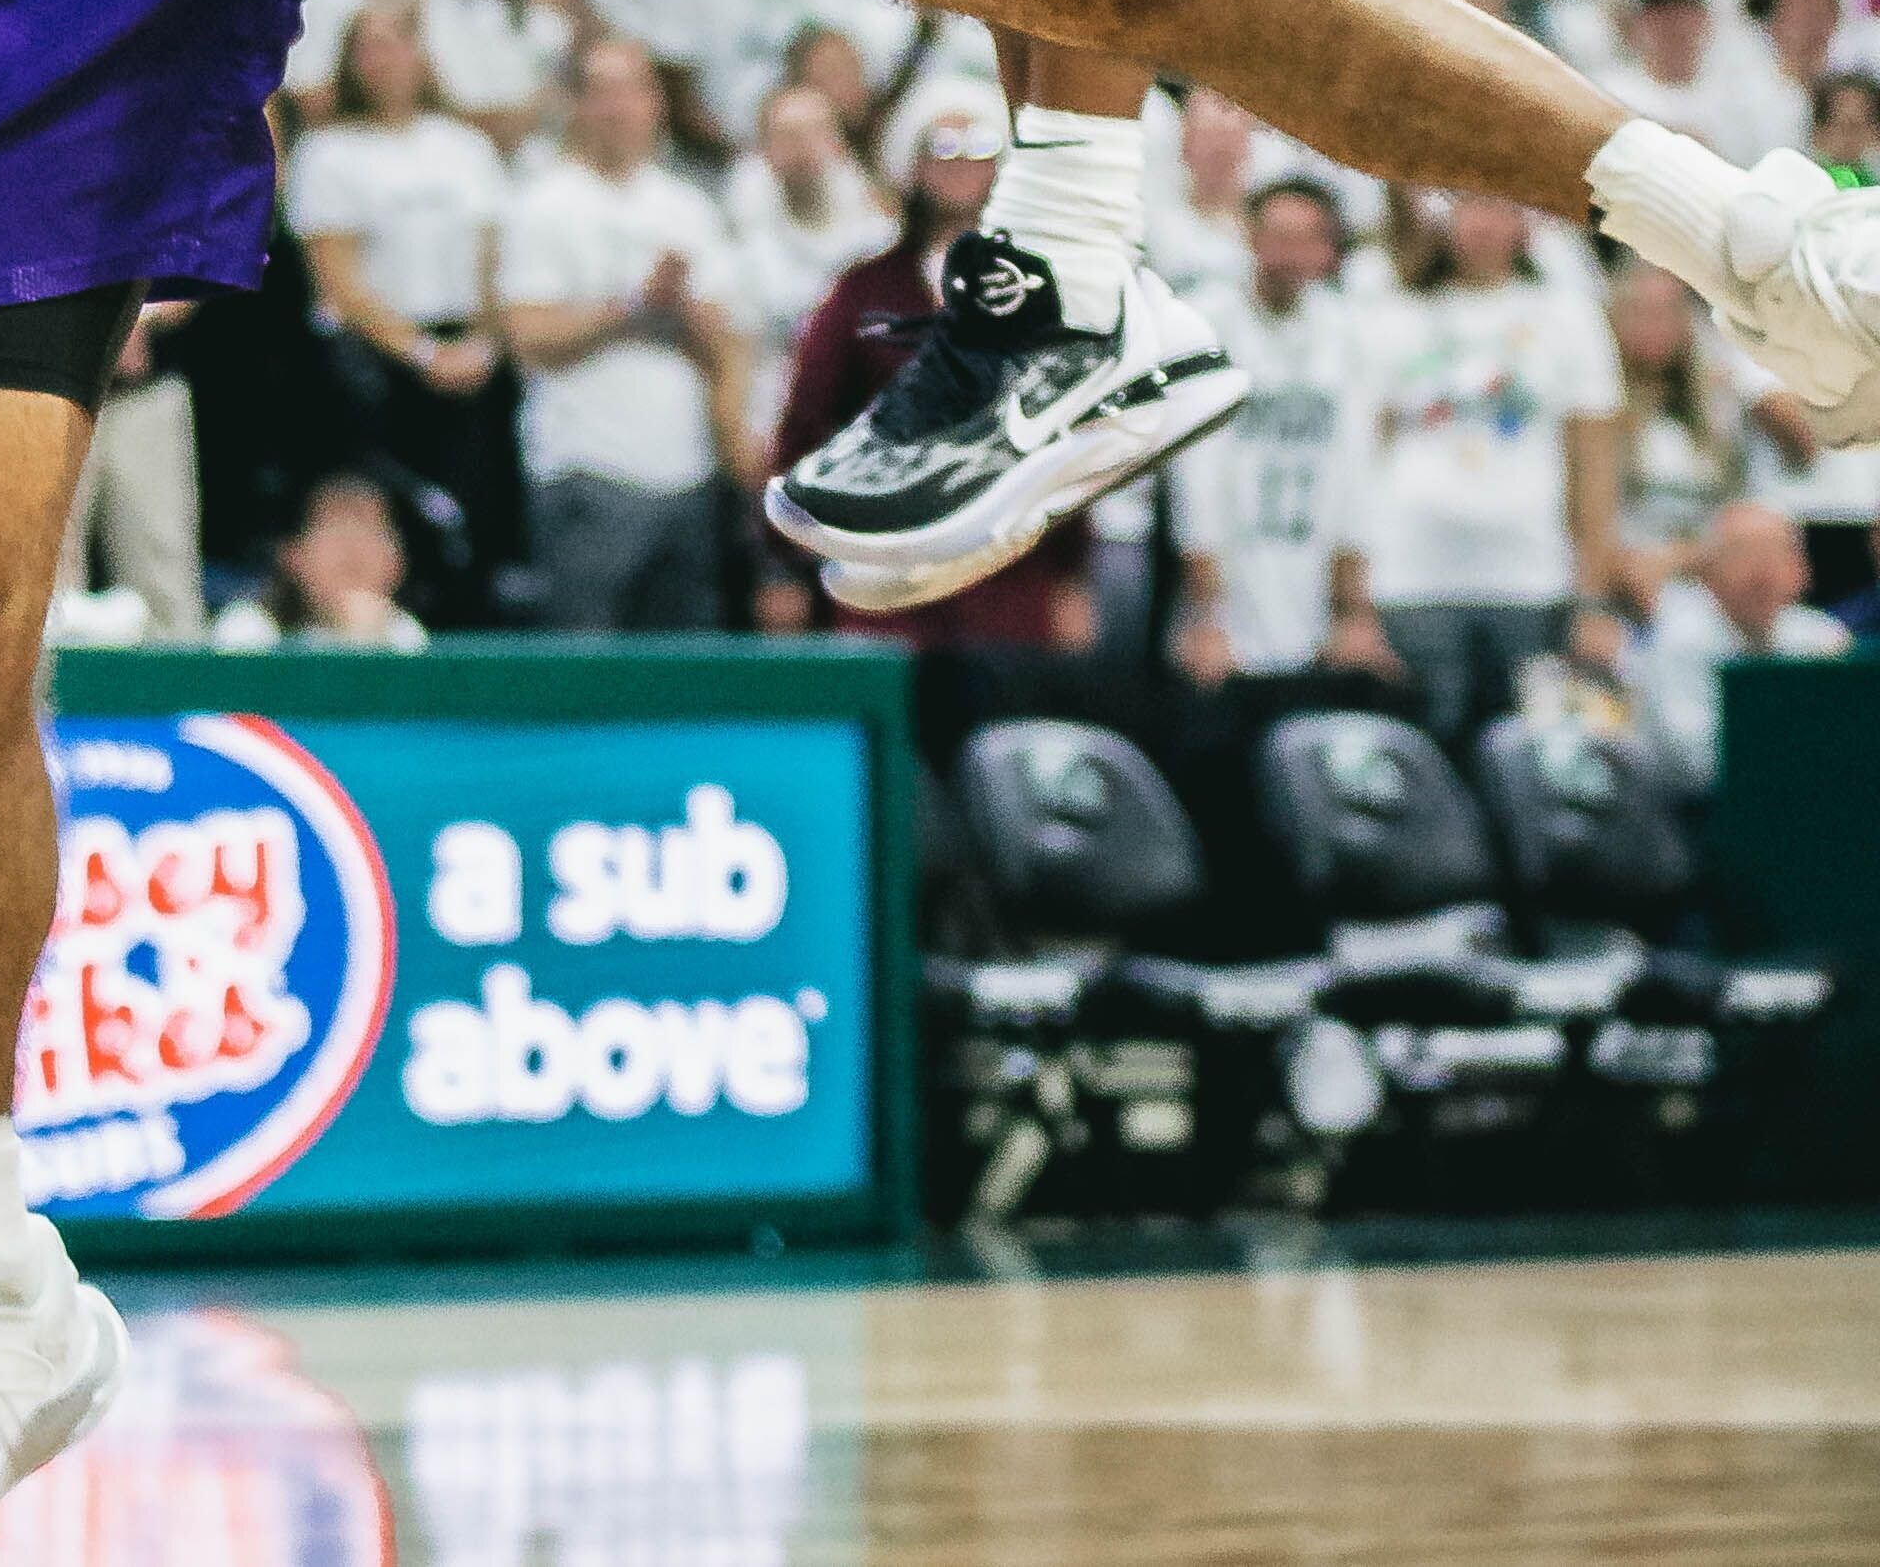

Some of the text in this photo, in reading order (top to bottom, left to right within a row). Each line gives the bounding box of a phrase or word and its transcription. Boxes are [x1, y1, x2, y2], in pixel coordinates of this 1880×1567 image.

[428, 782, 787, 947] a sub
[403, 963, 812, 1126] above
